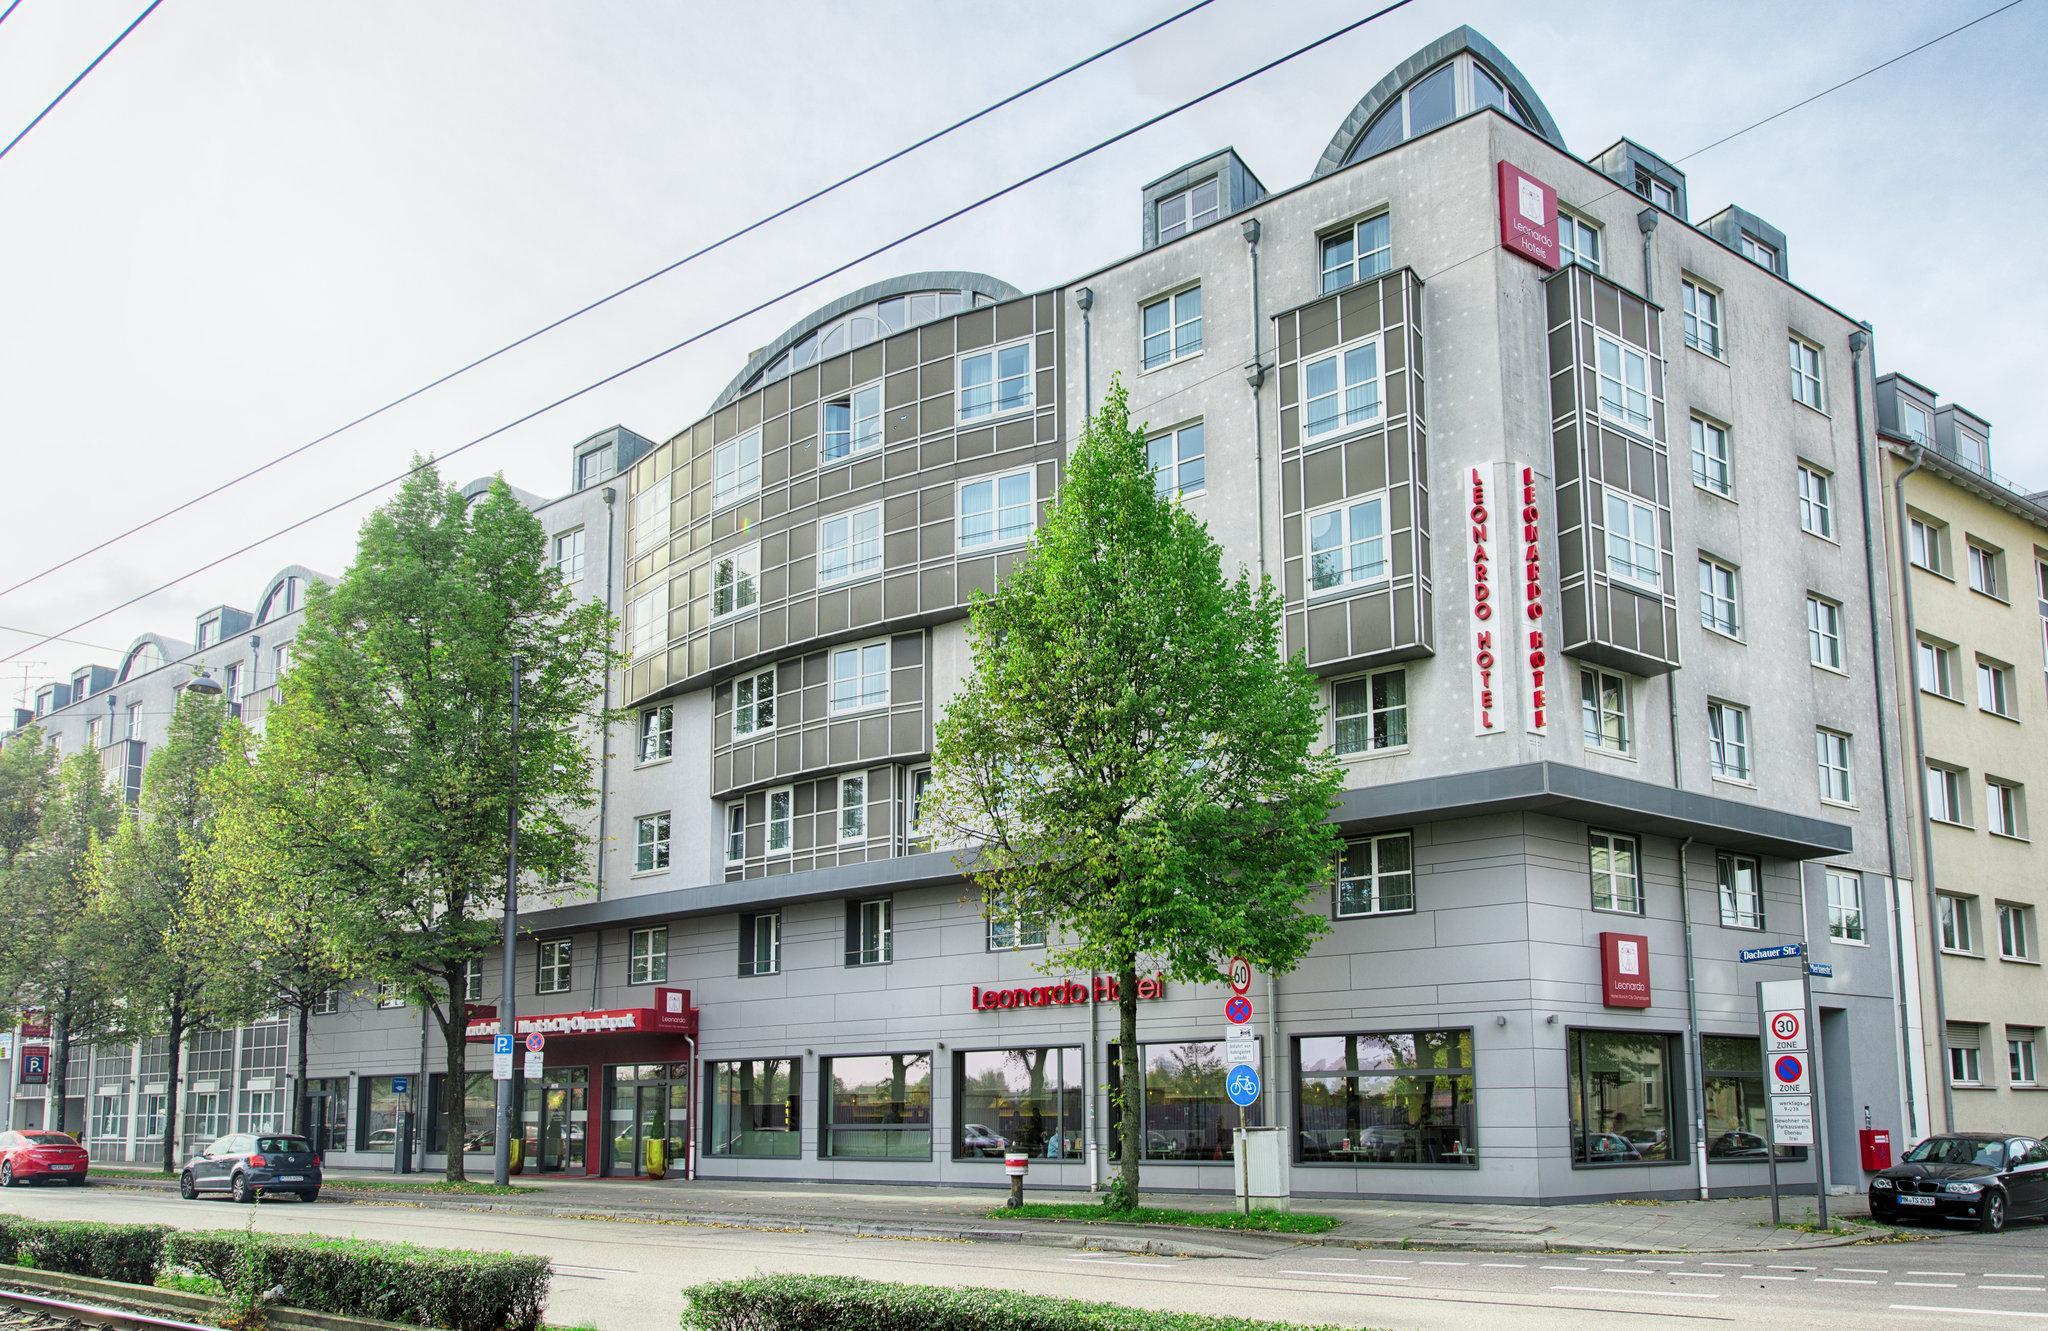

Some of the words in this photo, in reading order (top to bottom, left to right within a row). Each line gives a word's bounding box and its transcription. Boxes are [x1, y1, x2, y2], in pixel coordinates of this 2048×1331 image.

[1513, 218, 1553, 248] Leonardo
[1521, 237, 1547, 259] Hotels
[1470, 468, 1492, 621] LEONARDO
[1522, 467, 1544, 621] LEONARDO
[1476, 631, 1494, 729] HOTEL
[1529, 630, 1547, 729] HOTEL
[1743, 949, 1781, 960] Dachauer
[1782, 946, 1797, 956] Str.
[1234, 966, 1247, 984] 60
[971, 979, 1089, 1011] Leonardo
[1093, 971, 1164, 1002] Hoel
[1614, 980, 1646, 991] Leonardo
[661, 1016, 686, 1024] Leonardo
[1777, 1020, 1794, 1033] 30
[1776, 1041, 1797, 1049] ZONE
[1780, 1084, 1800, 1092] ZONE
